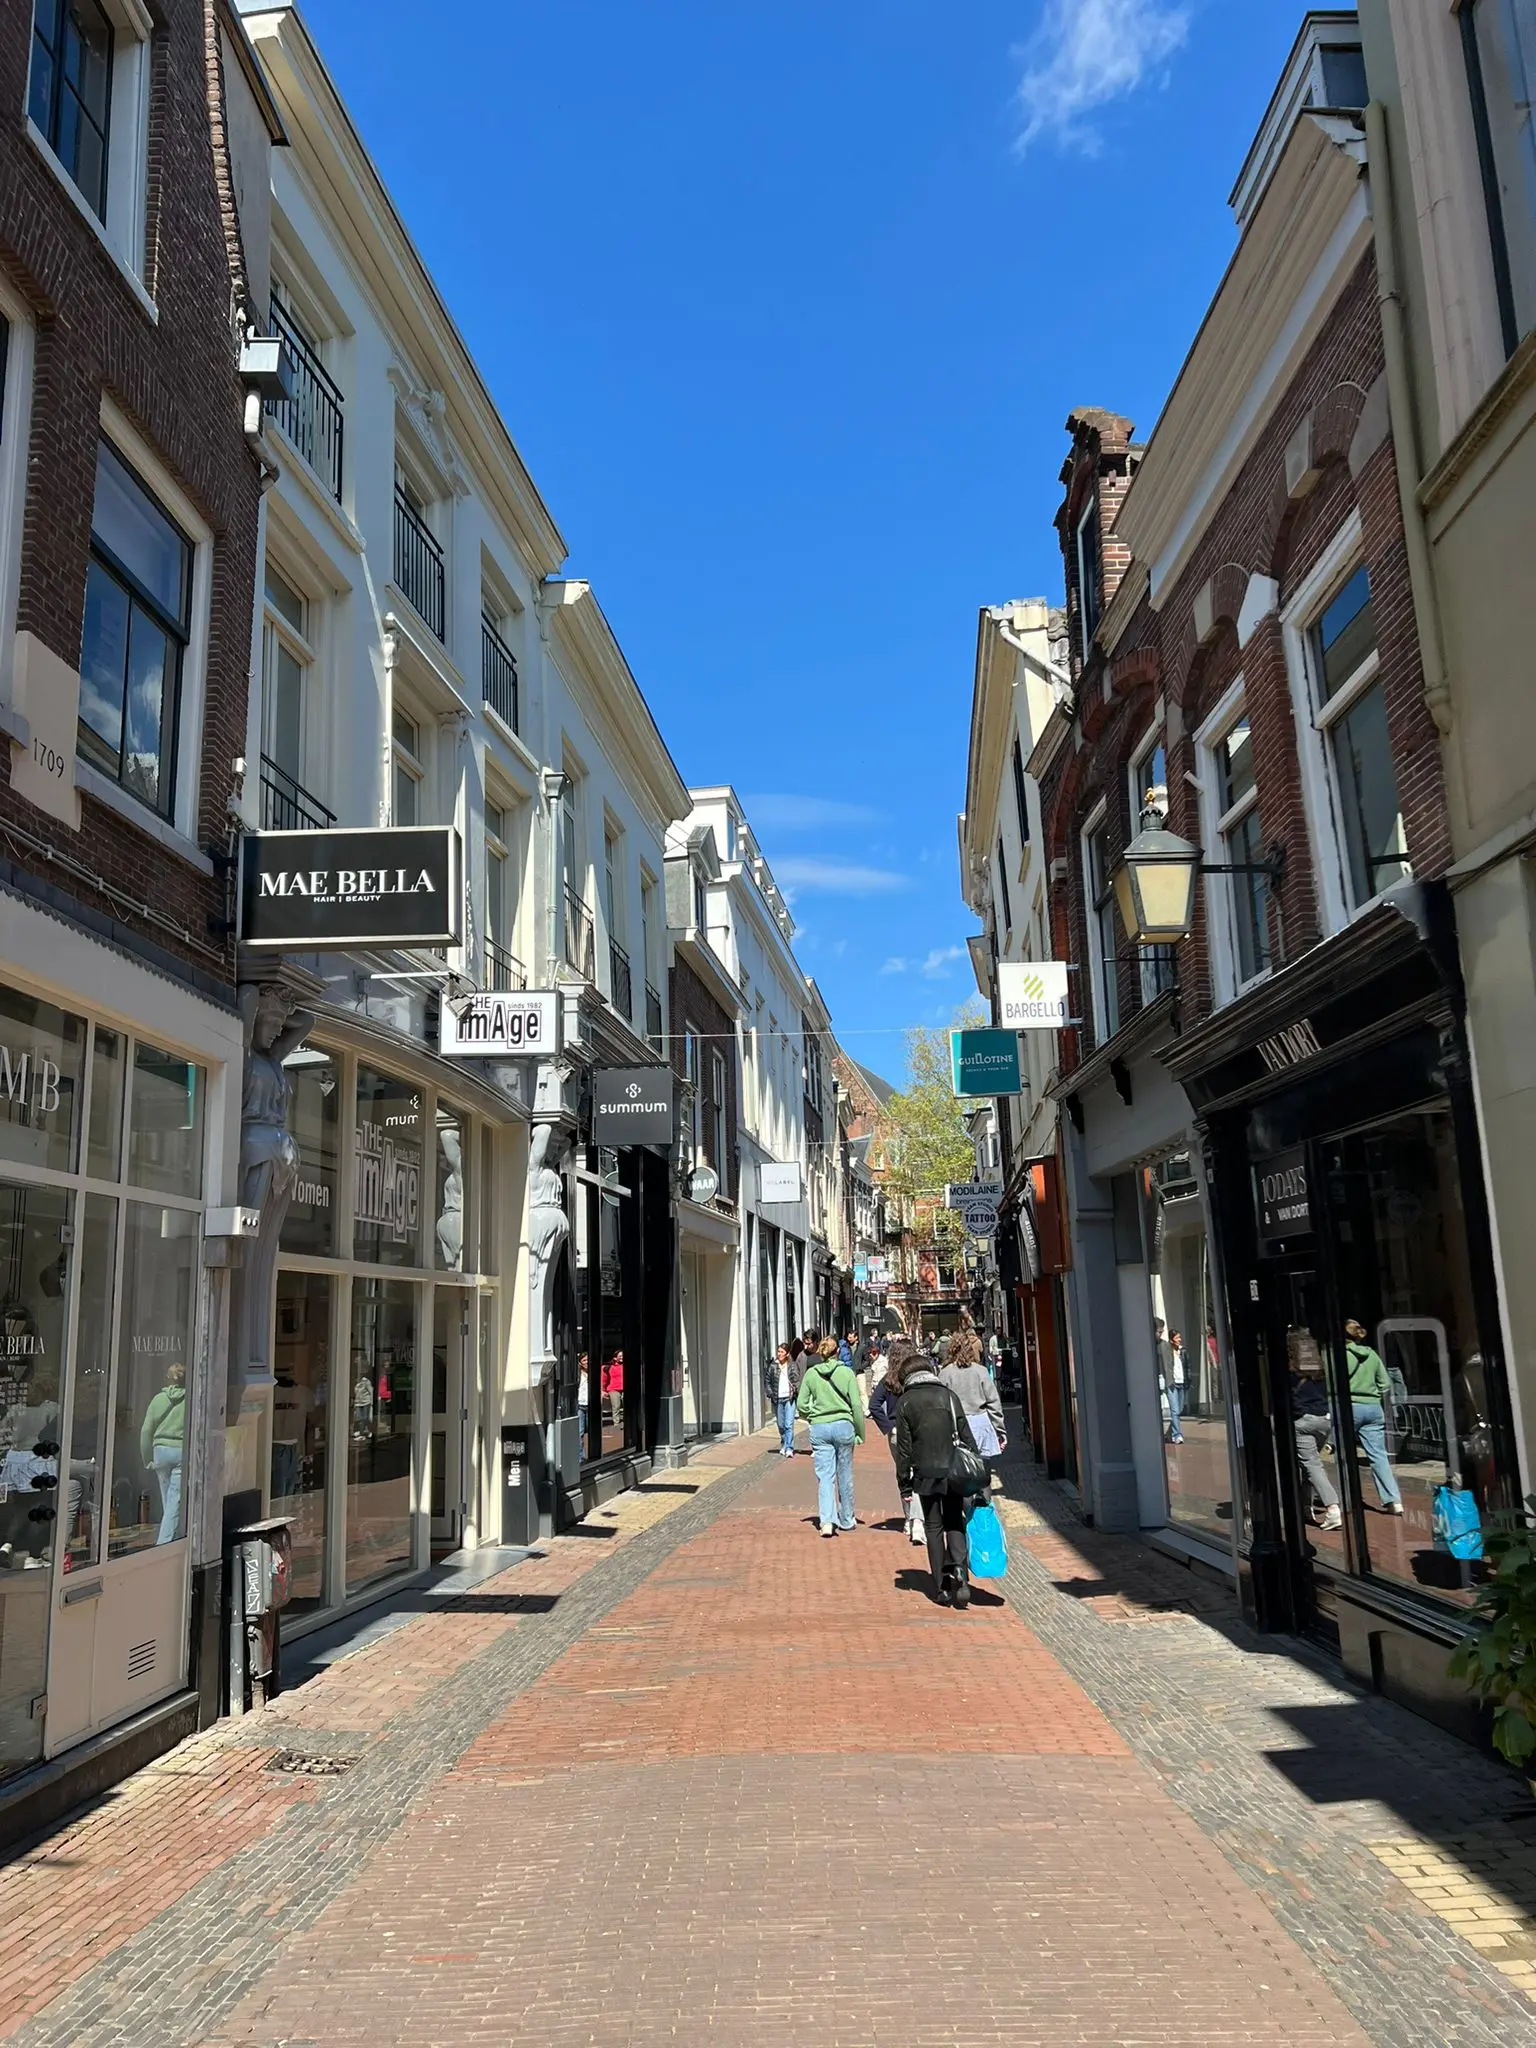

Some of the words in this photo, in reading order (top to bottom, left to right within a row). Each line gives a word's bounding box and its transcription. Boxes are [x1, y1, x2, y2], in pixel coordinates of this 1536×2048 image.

[33, 737, 64, 778] 1709
[259, 871, 328, 896] MAE
[335, 869, 436, 895] BELLA
[473, 997, 491, 1009] HE
[1005, 1001, 1065, 1018] BARGELLO
[1256, 1036, 1290, 1072] VAN
[1279, 1018, 1321, 1063] DORT
[958, 1052, 1014, 1066] GUILLOTINE
[600, 1102, 667, 1114] summum
[363, 1120, 383, 1152] THE
[950, 1185, 999, 1196] MODILAINE
[1261, 1165, 1307, 1203] 10DAYS
[964, 1213, 996, 1223] TATTOO
[7, 1335, 45, 1354] BELLA
[508, 1460, 520, 1486] Men
